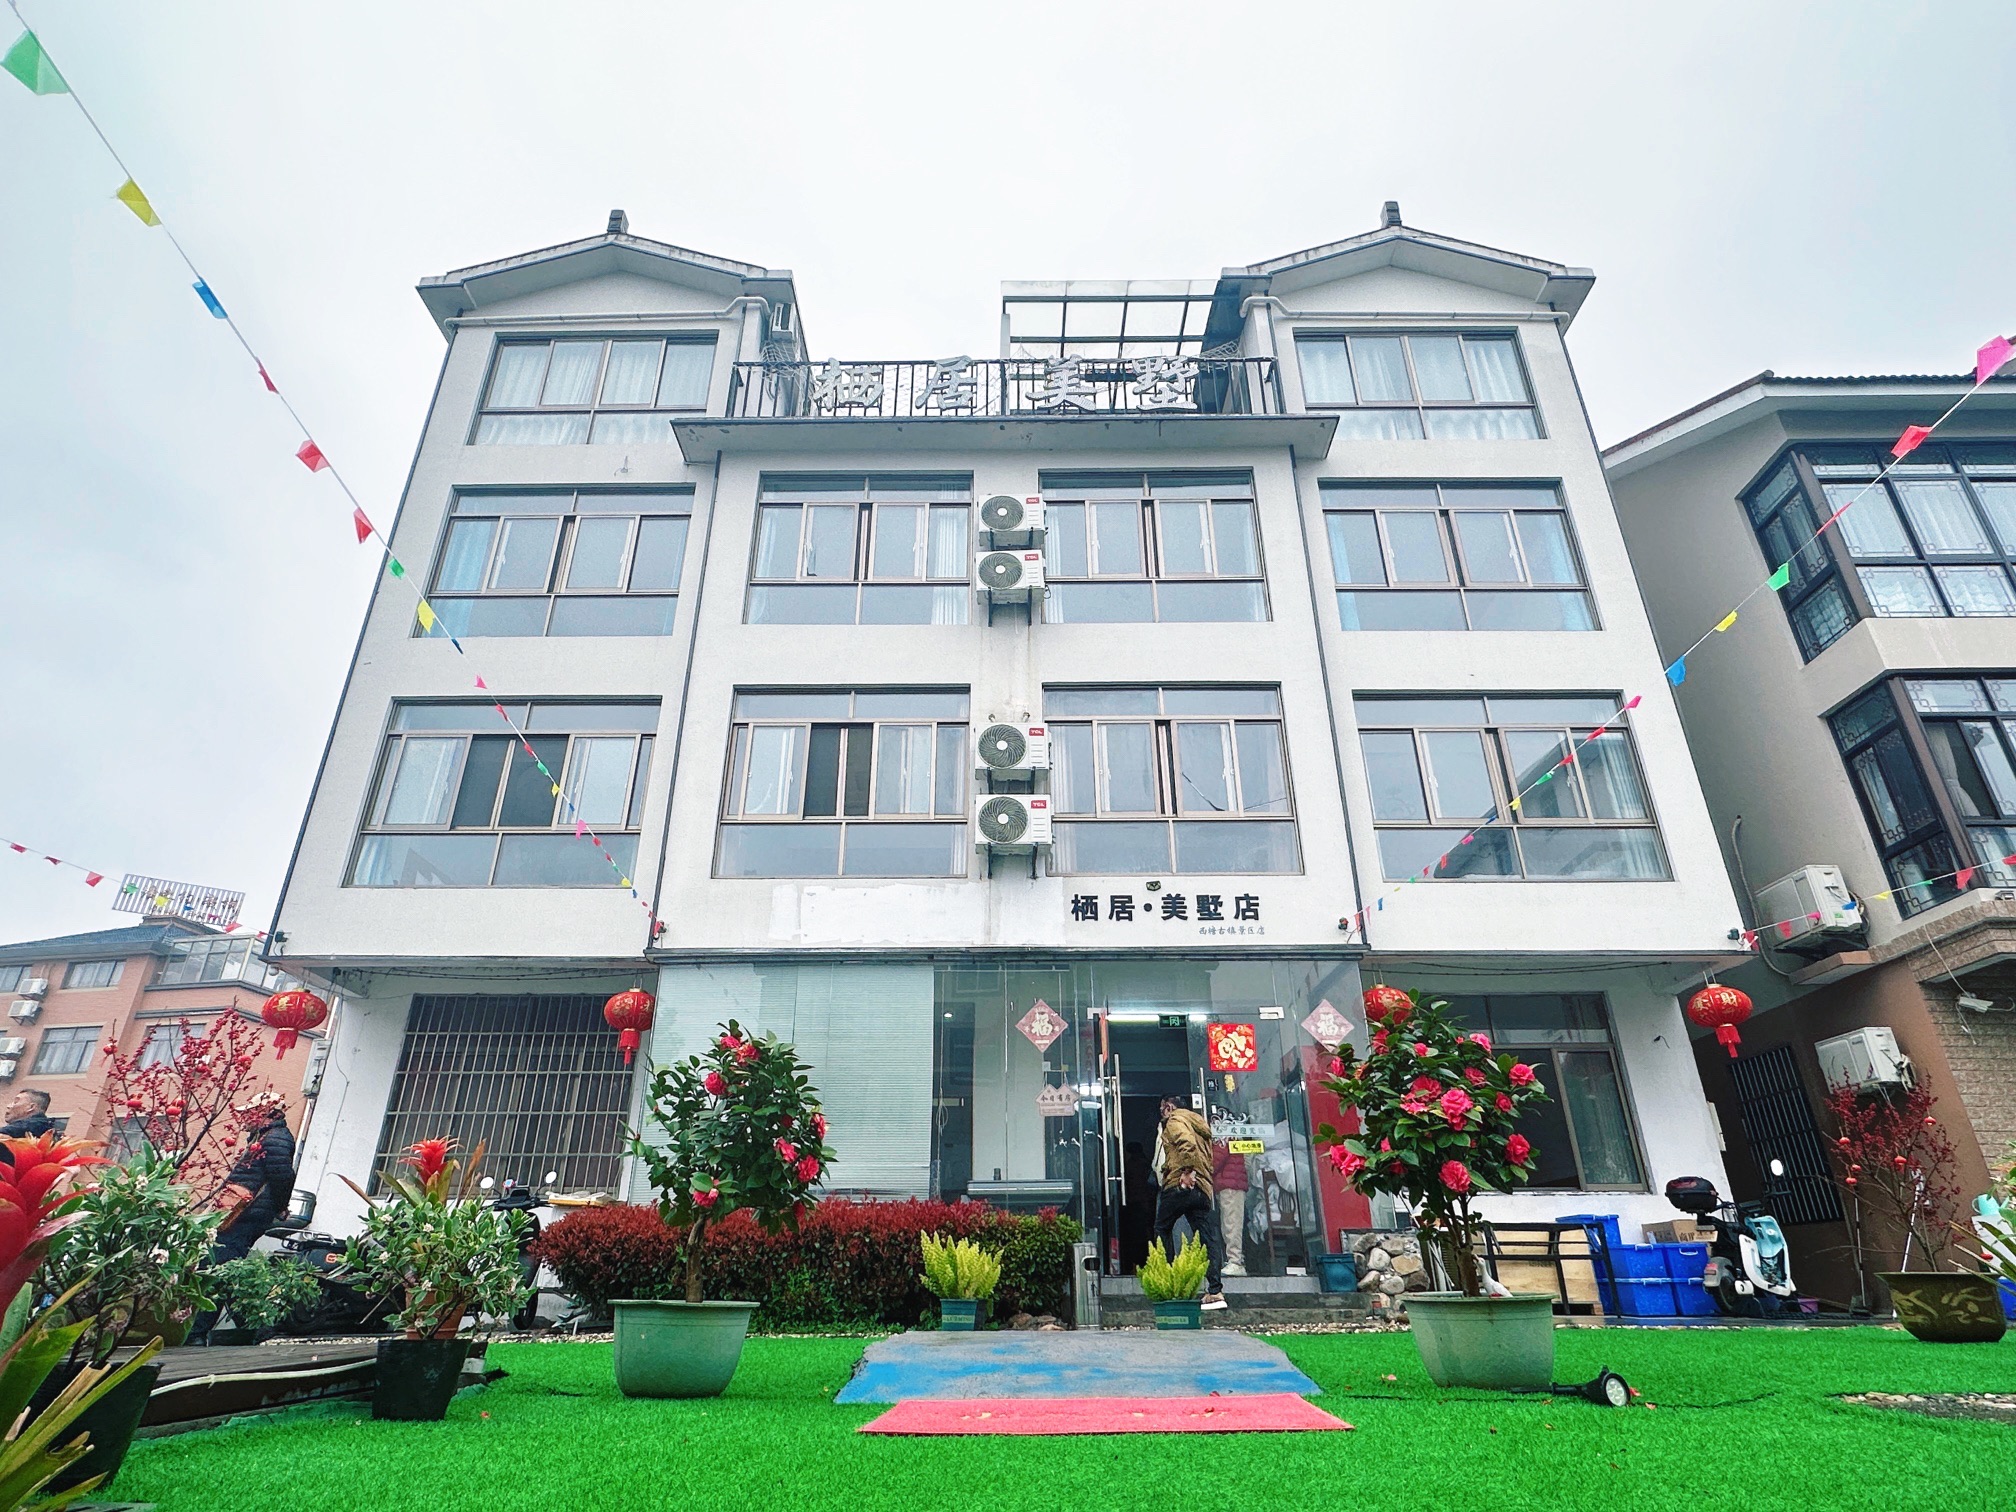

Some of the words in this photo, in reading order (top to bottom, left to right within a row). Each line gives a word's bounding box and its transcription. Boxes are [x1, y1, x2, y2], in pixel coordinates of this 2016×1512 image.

[813, 354, 1199, 411] 栖居美墅
[1031, 1011, 1053, 1037] 福
[1317, 1013, 1339, 1037] 福
